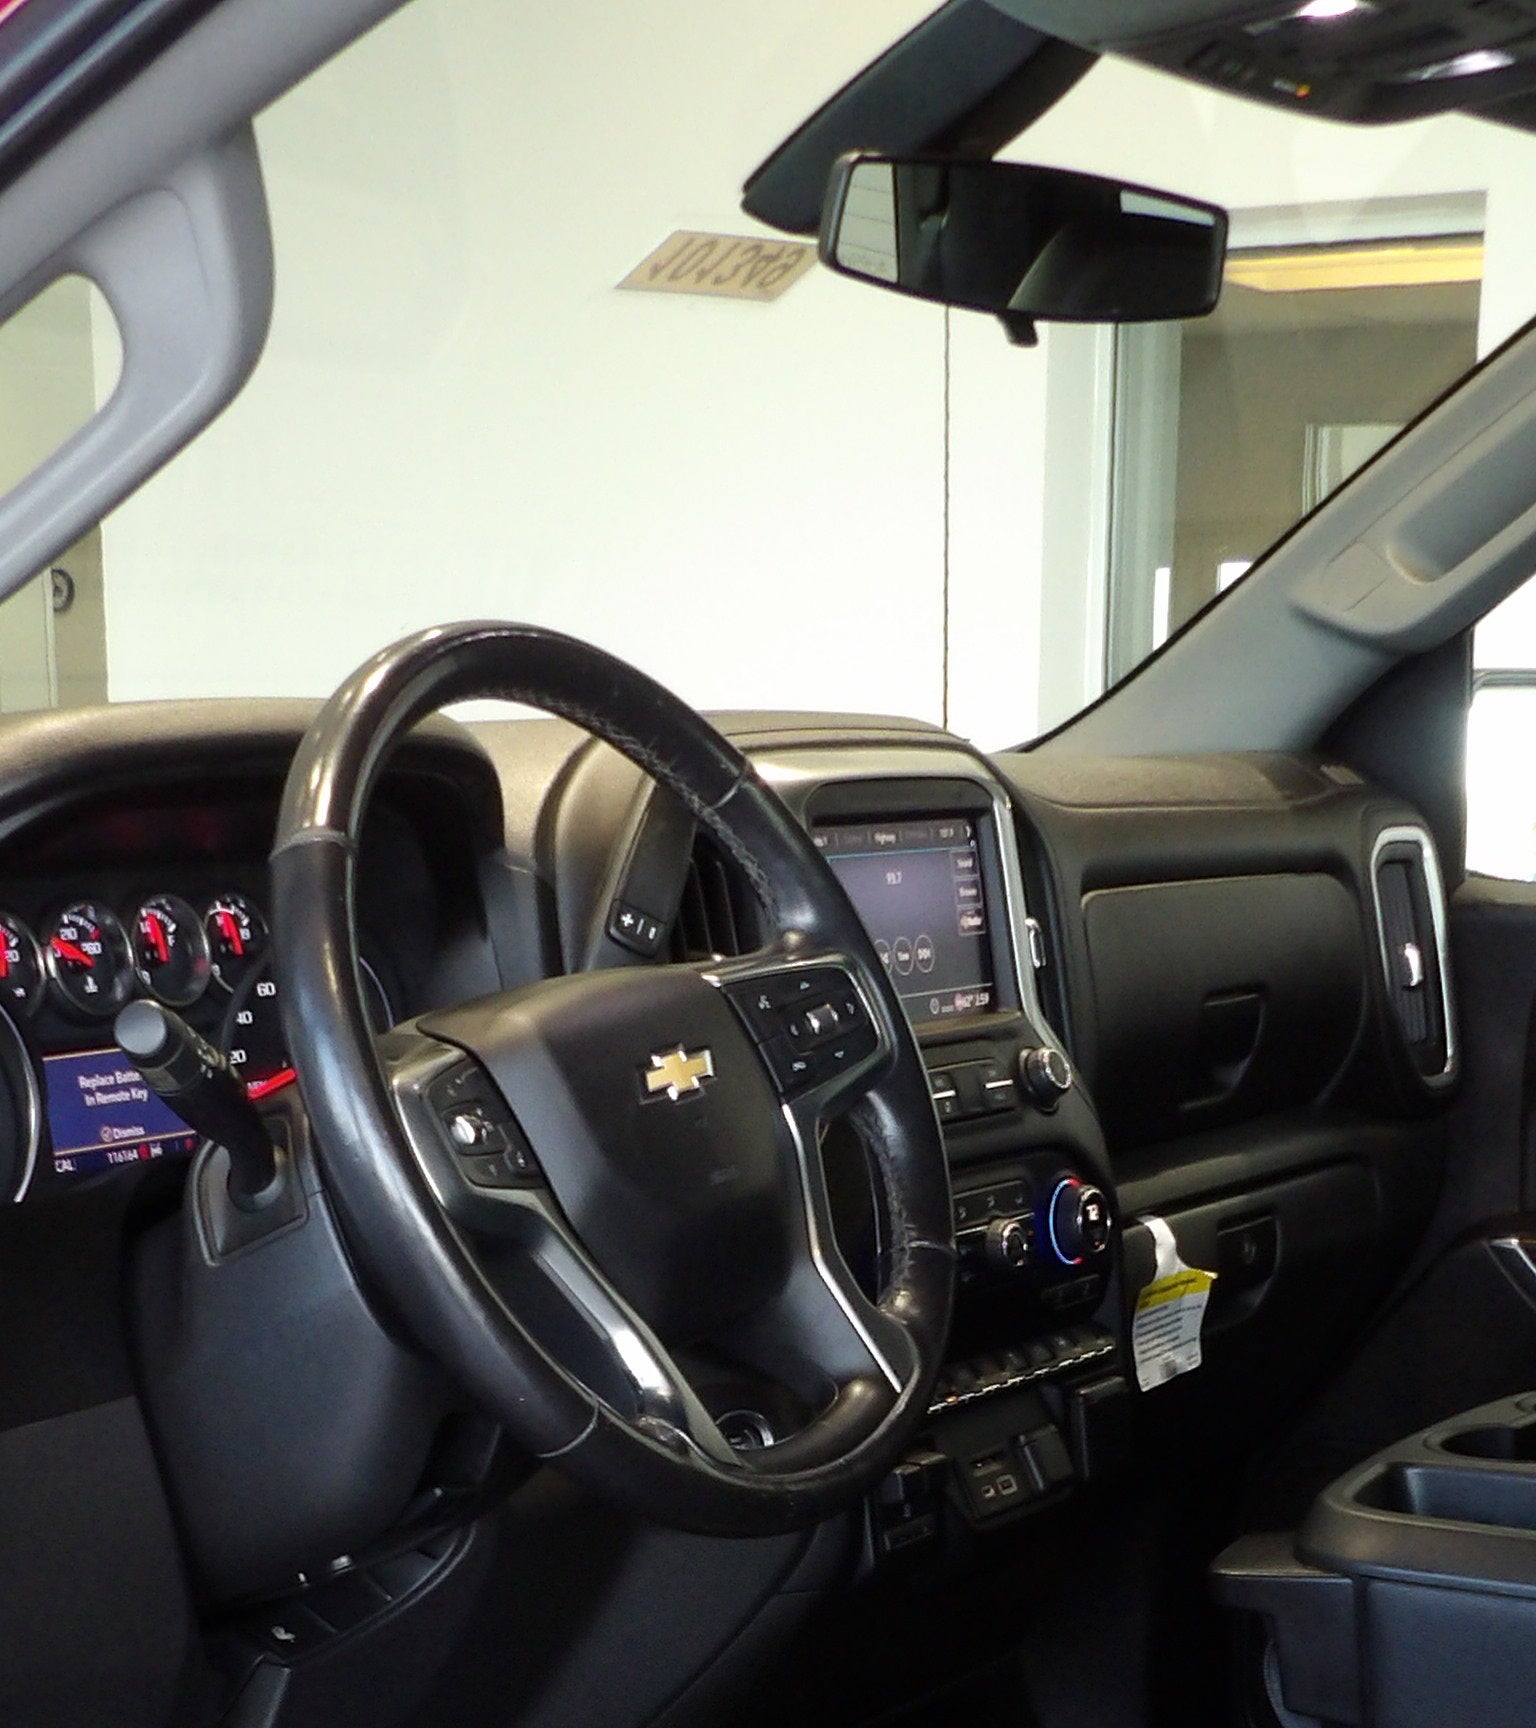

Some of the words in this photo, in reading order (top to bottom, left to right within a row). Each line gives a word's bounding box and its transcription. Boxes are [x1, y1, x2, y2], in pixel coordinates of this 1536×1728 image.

[256, 982, 276, 997] 60
[229, 1049, 247, 1065] 20
[78, 1074, 115, 1091] Replace
[95, 1091, 131, 1106] Remote
[130, 1087, 148, 1102] Key
